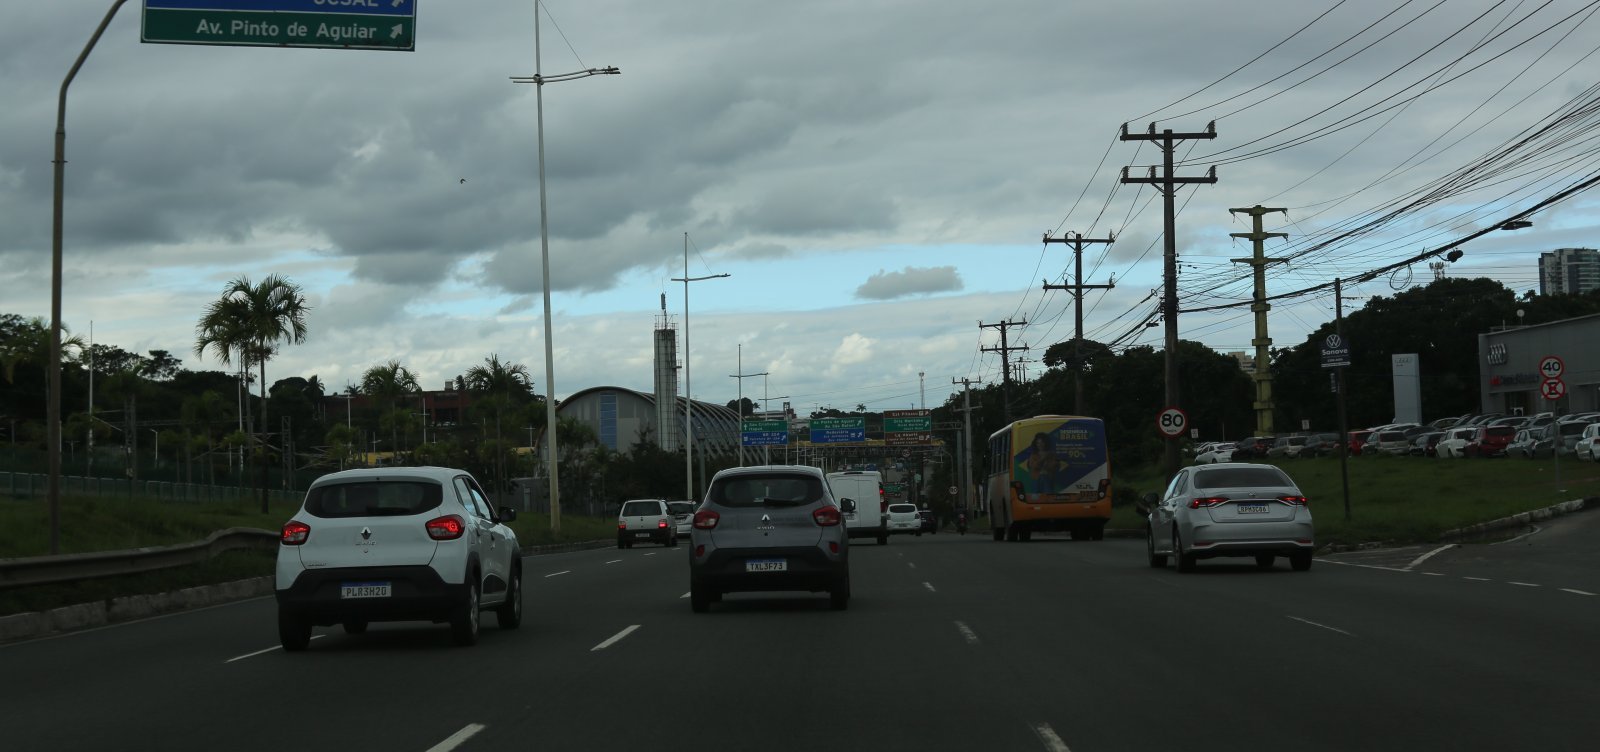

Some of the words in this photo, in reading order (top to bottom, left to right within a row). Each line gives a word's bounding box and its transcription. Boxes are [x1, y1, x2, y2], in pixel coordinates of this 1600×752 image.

[196, 19, 224, 35] Av.
[230, 20, 280, 37] Pinto
[286, 21, 308, 38] de
[315, 22, 377, 42] Aguiar
[1321, 348, 1348, 356] Sanave
[1543, 361, 1561, 372] 40
[1161, 413, 1184, 427] 80
[346, 586, 387, 597] PLR3H20
